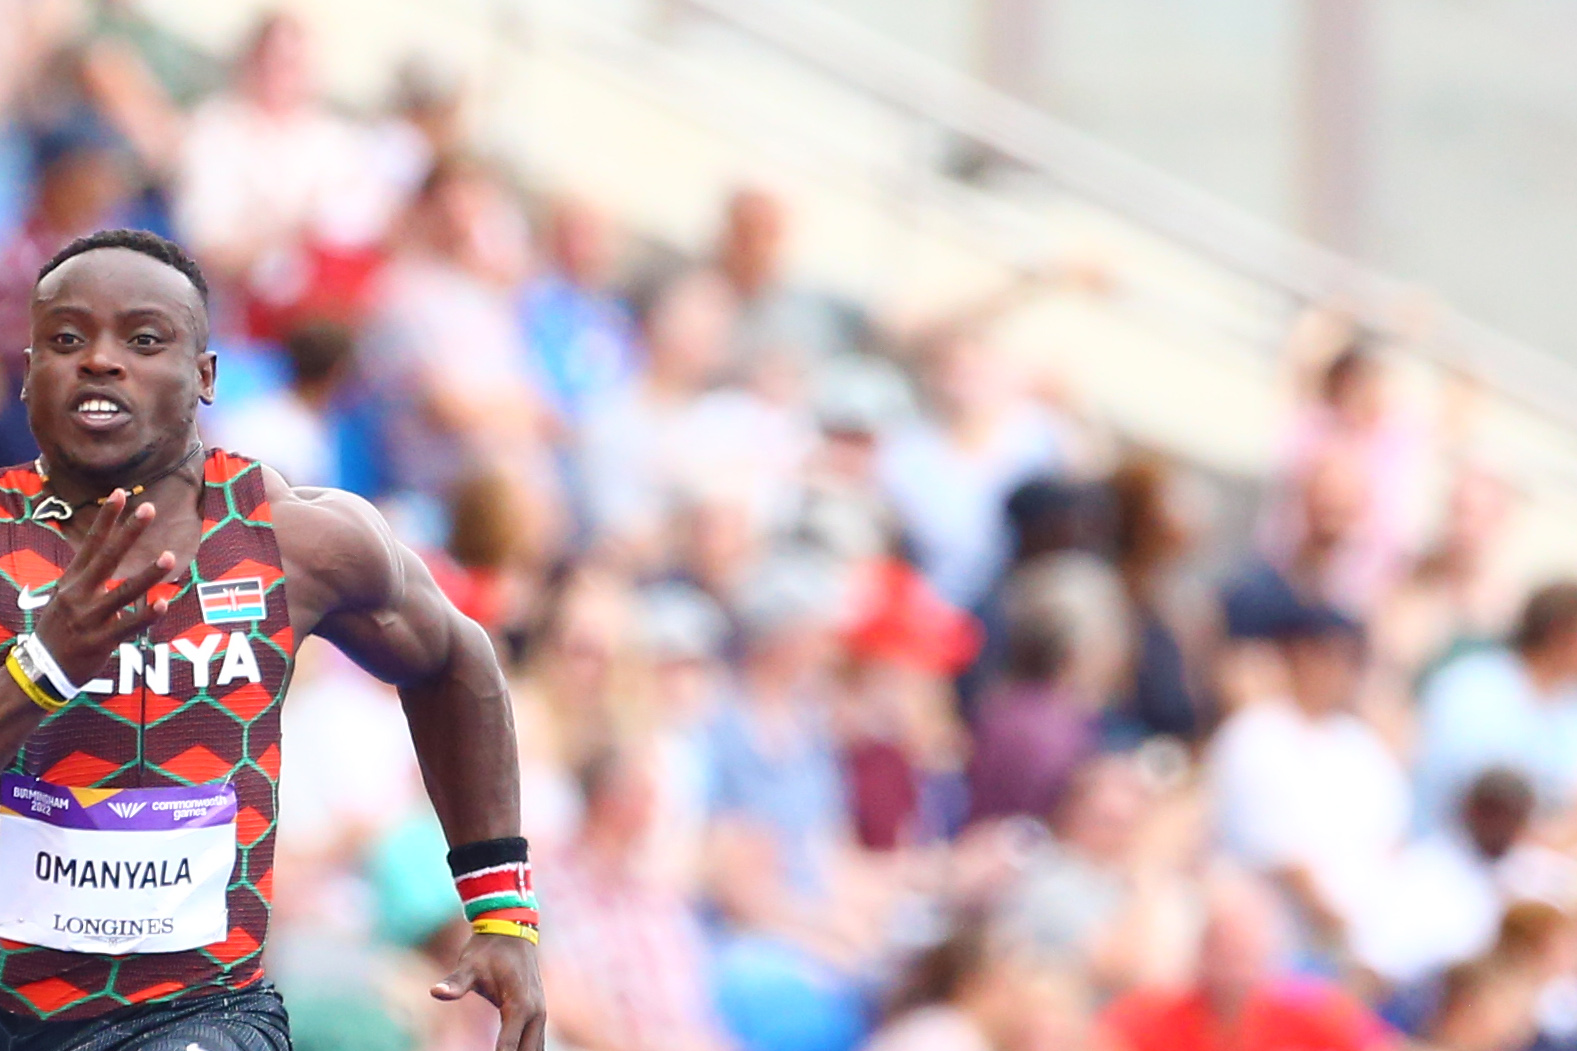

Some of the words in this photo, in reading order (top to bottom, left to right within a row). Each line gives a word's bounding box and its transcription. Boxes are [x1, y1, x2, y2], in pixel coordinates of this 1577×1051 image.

[13, 787, 69, 810] BIRMINGHAM
[151, 795, 227, 811] commonwealth
[31, 801, 51, 816] 2022
[173, 808, 207, 821] games
[35, 851, 192, 889] OMANYALA
[53, 914, 174, 936] LONGINES
